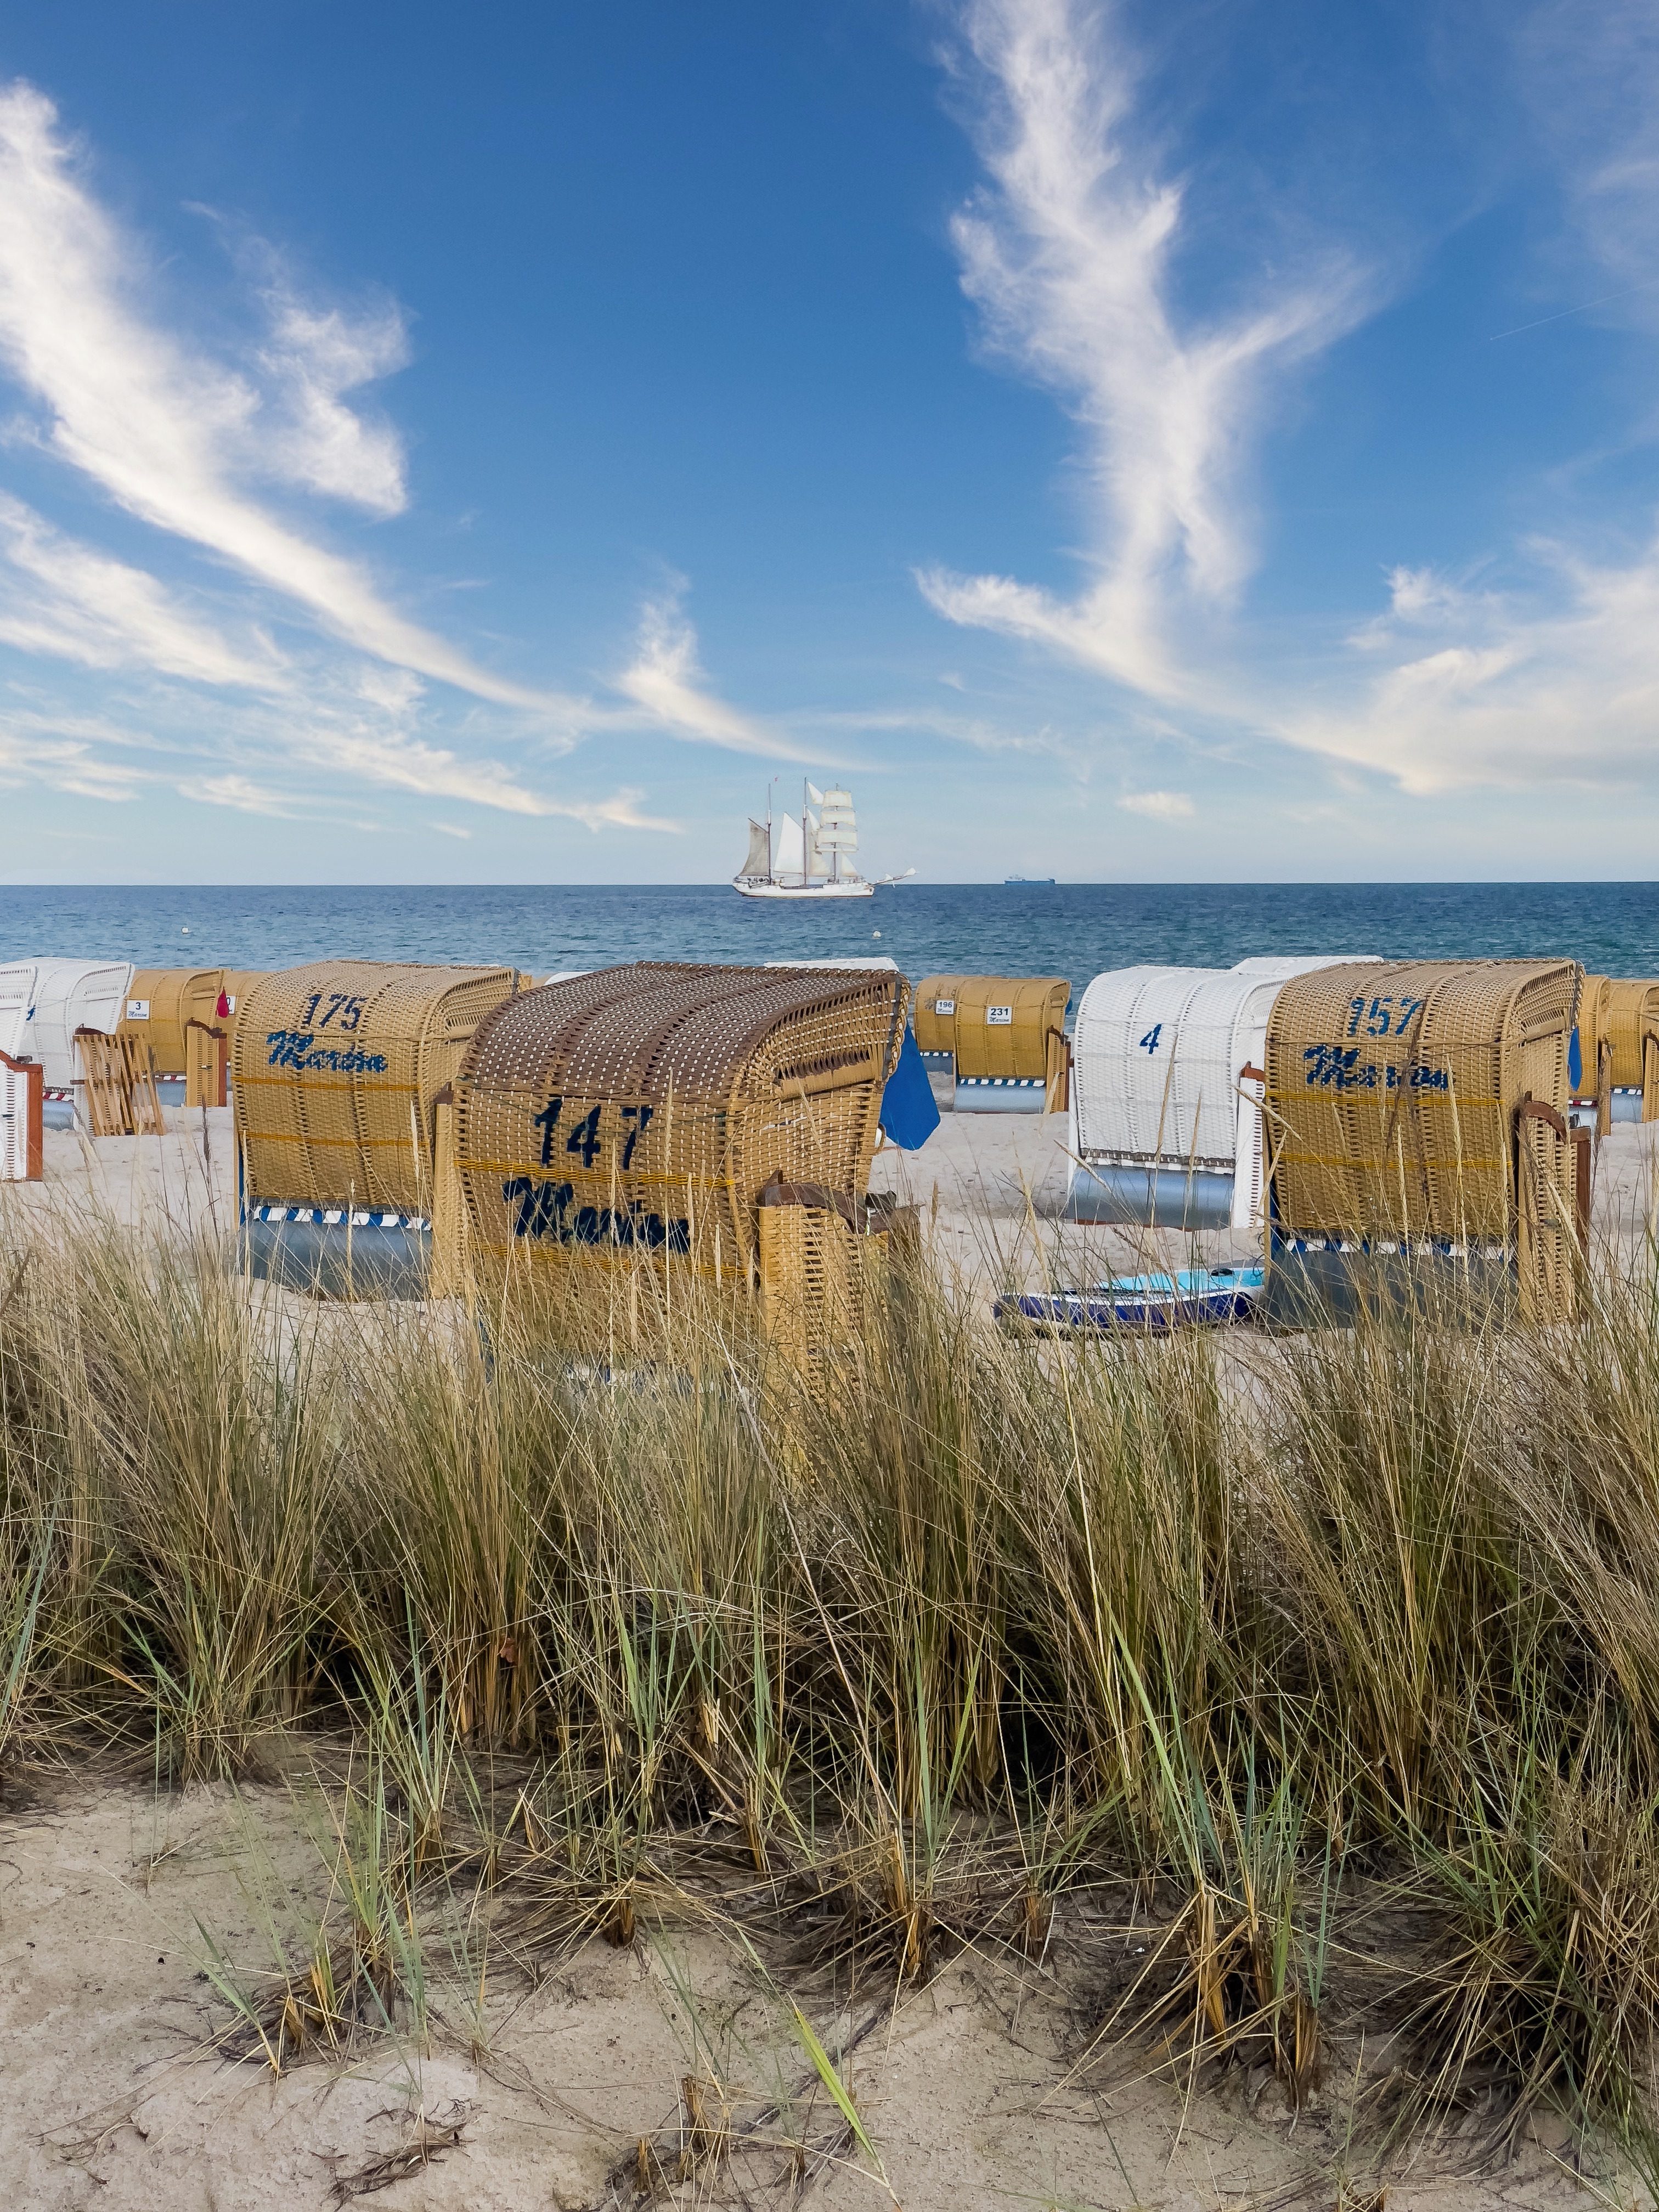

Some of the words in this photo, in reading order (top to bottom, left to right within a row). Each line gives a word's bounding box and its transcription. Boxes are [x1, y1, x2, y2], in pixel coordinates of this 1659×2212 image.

[136, 1002, 141, 1010] 3
[302, 994, 369, 1030] 175
[1350, 997, 1424, 1036] 157
[1139, 1024, 1162, 1054] 4
[534, 1098, 654, 1170] 147
